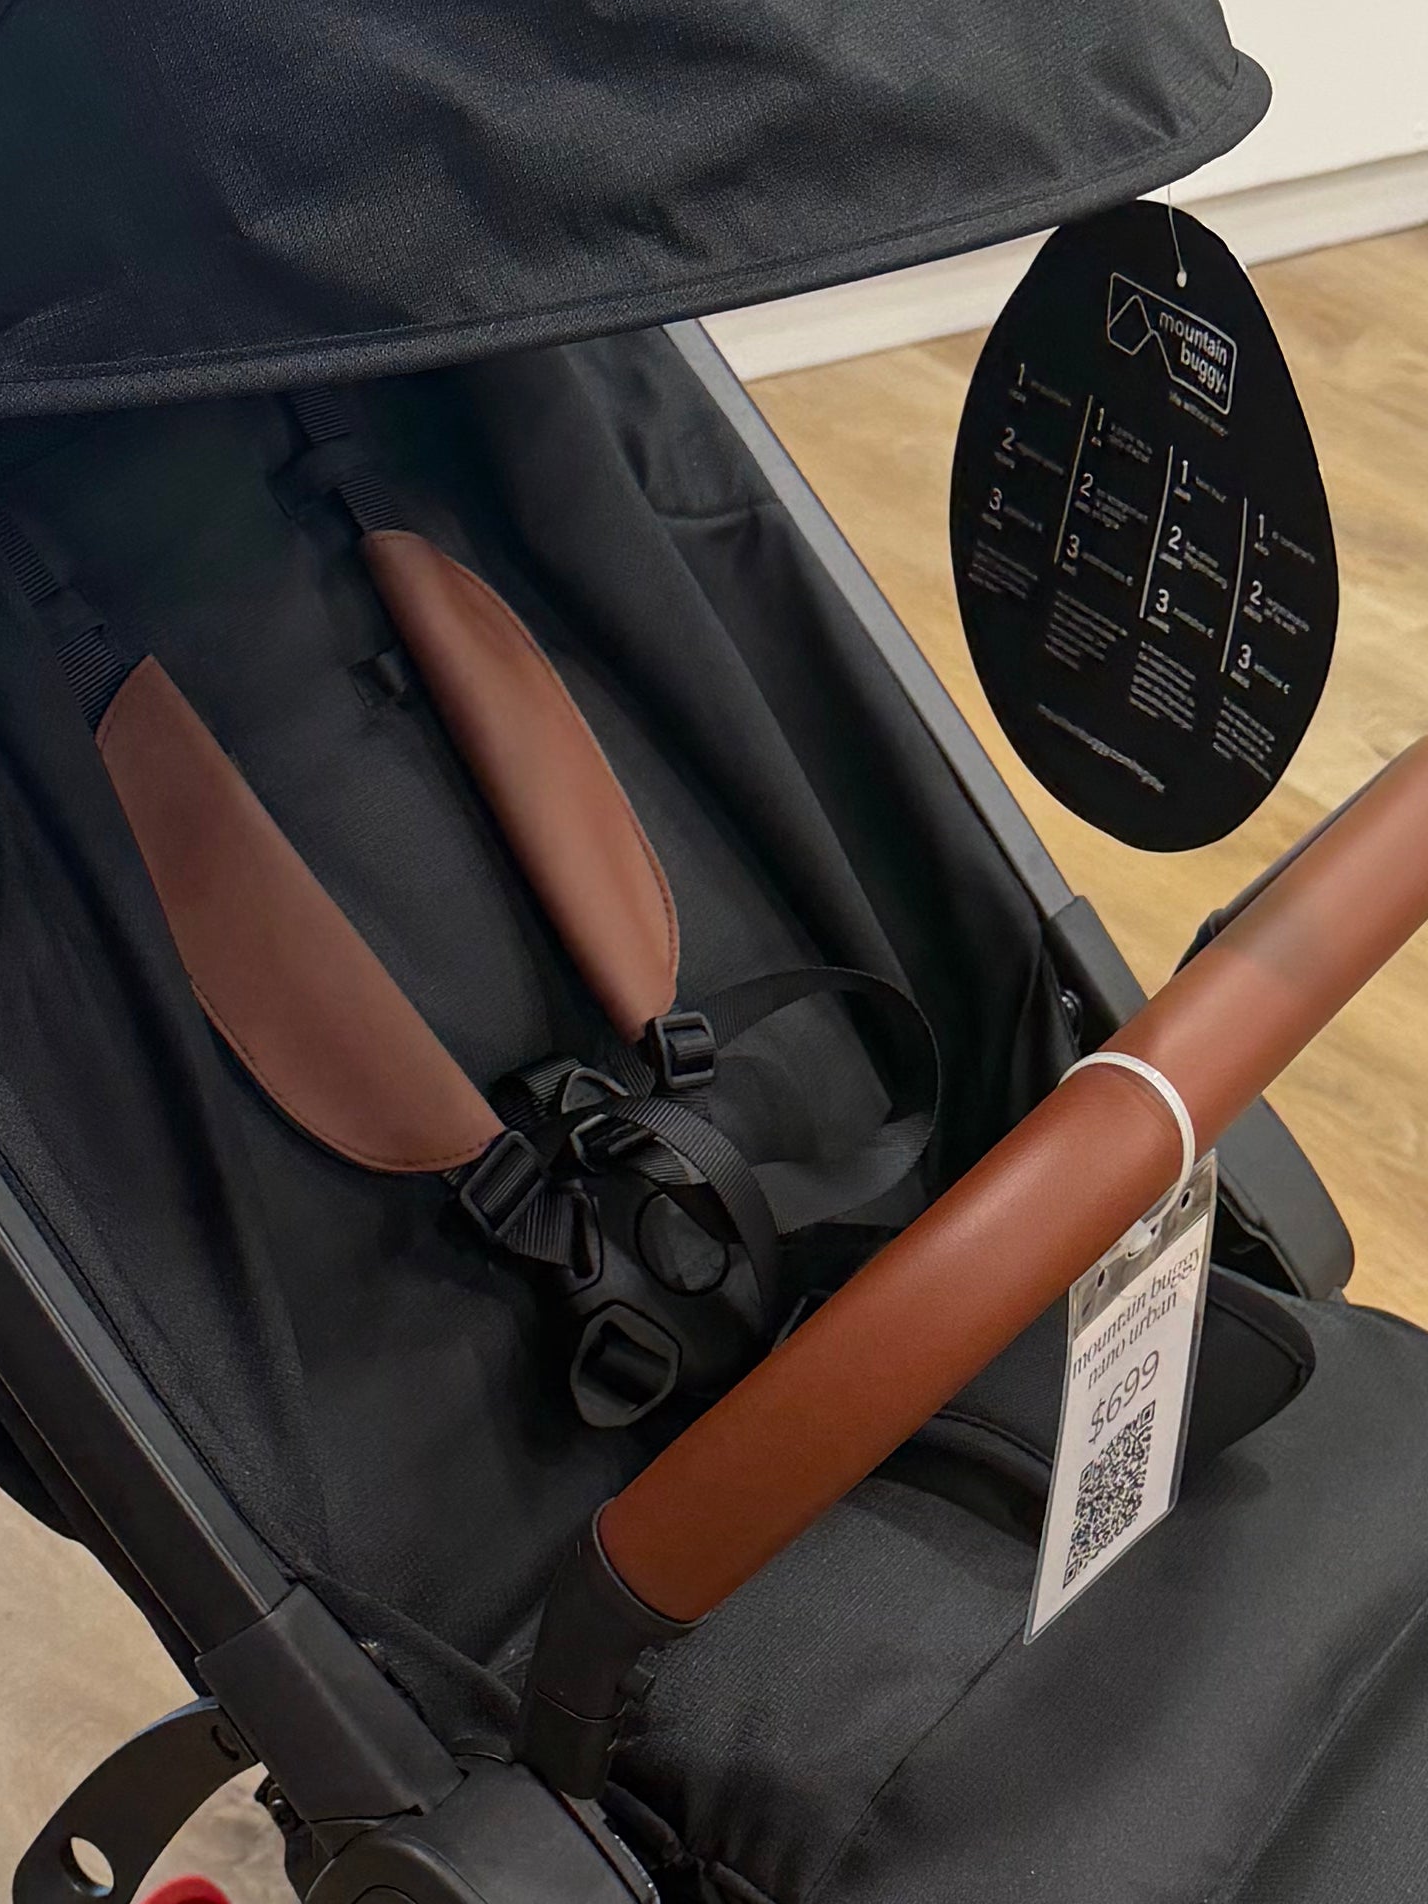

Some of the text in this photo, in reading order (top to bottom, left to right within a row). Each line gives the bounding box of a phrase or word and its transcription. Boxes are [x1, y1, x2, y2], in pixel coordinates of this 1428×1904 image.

[1159, 311, 1227, 366] mountain
[1002, 427, 1015, 451] 2
[1080, 473, 1094, 496] 2
[989, 488, 1002, 511] 3
[1067, 534, 1080, 558] 3
[1168, 526, 1182, 550] 2
[1156, 589, 1169, 613] 3
[1249, 581, 1262, 606] 2
[1238, 644, 1251, 669] 3
[1072, 1248, 1200, 1380] mountain buggy
[1088, 1292, 1177, 1389] nano urban
[1088, 1350, 1160, 1444] $699
